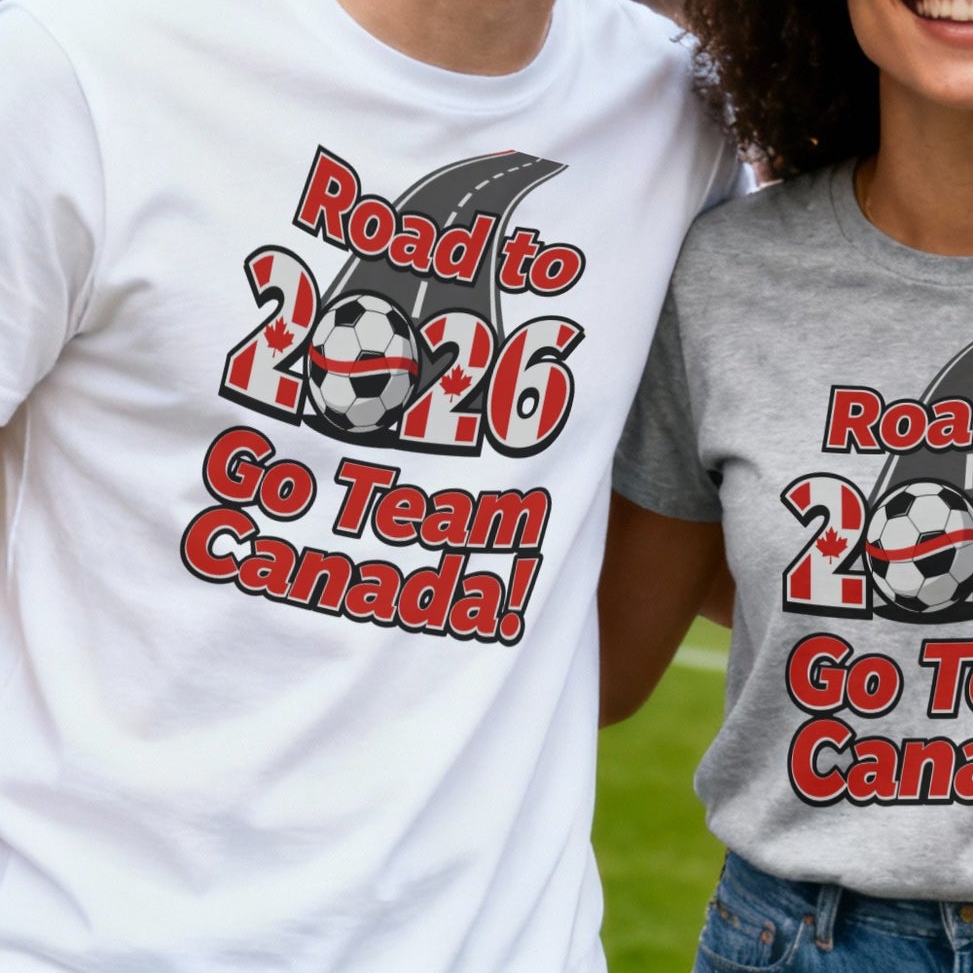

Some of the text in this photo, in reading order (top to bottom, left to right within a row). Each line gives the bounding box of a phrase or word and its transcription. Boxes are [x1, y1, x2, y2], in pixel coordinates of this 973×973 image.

[293, 145, 586, 297] Road to
[202, 426, 551, 554] Go Team
[180, 505, 543, 646] Canada!
[785, 632, 904, 719] Go
